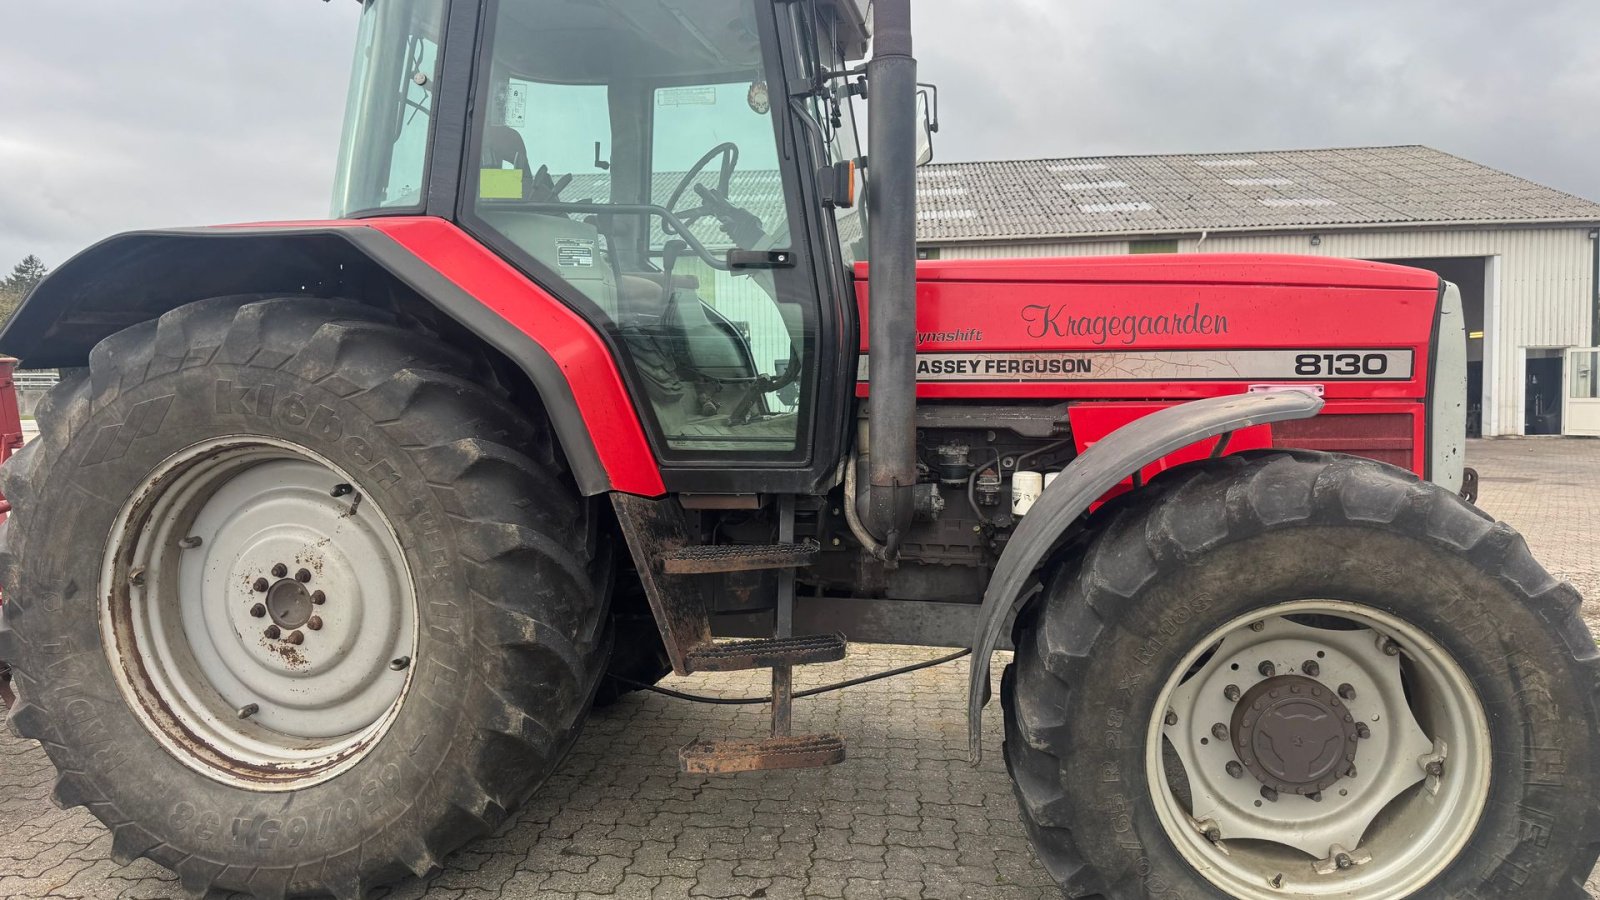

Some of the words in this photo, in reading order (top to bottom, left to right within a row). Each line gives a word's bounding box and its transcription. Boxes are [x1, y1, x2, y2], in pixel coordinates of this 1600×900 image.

[1021, 302, 1228, 344] Kragegaarden
[916, 329, 982, 345] ynashift
[917, 360, 981, 373] ASSEY
[985, 359, 1091, 373] FERGUSON
[1295, 353, 1387, 375] 8130
